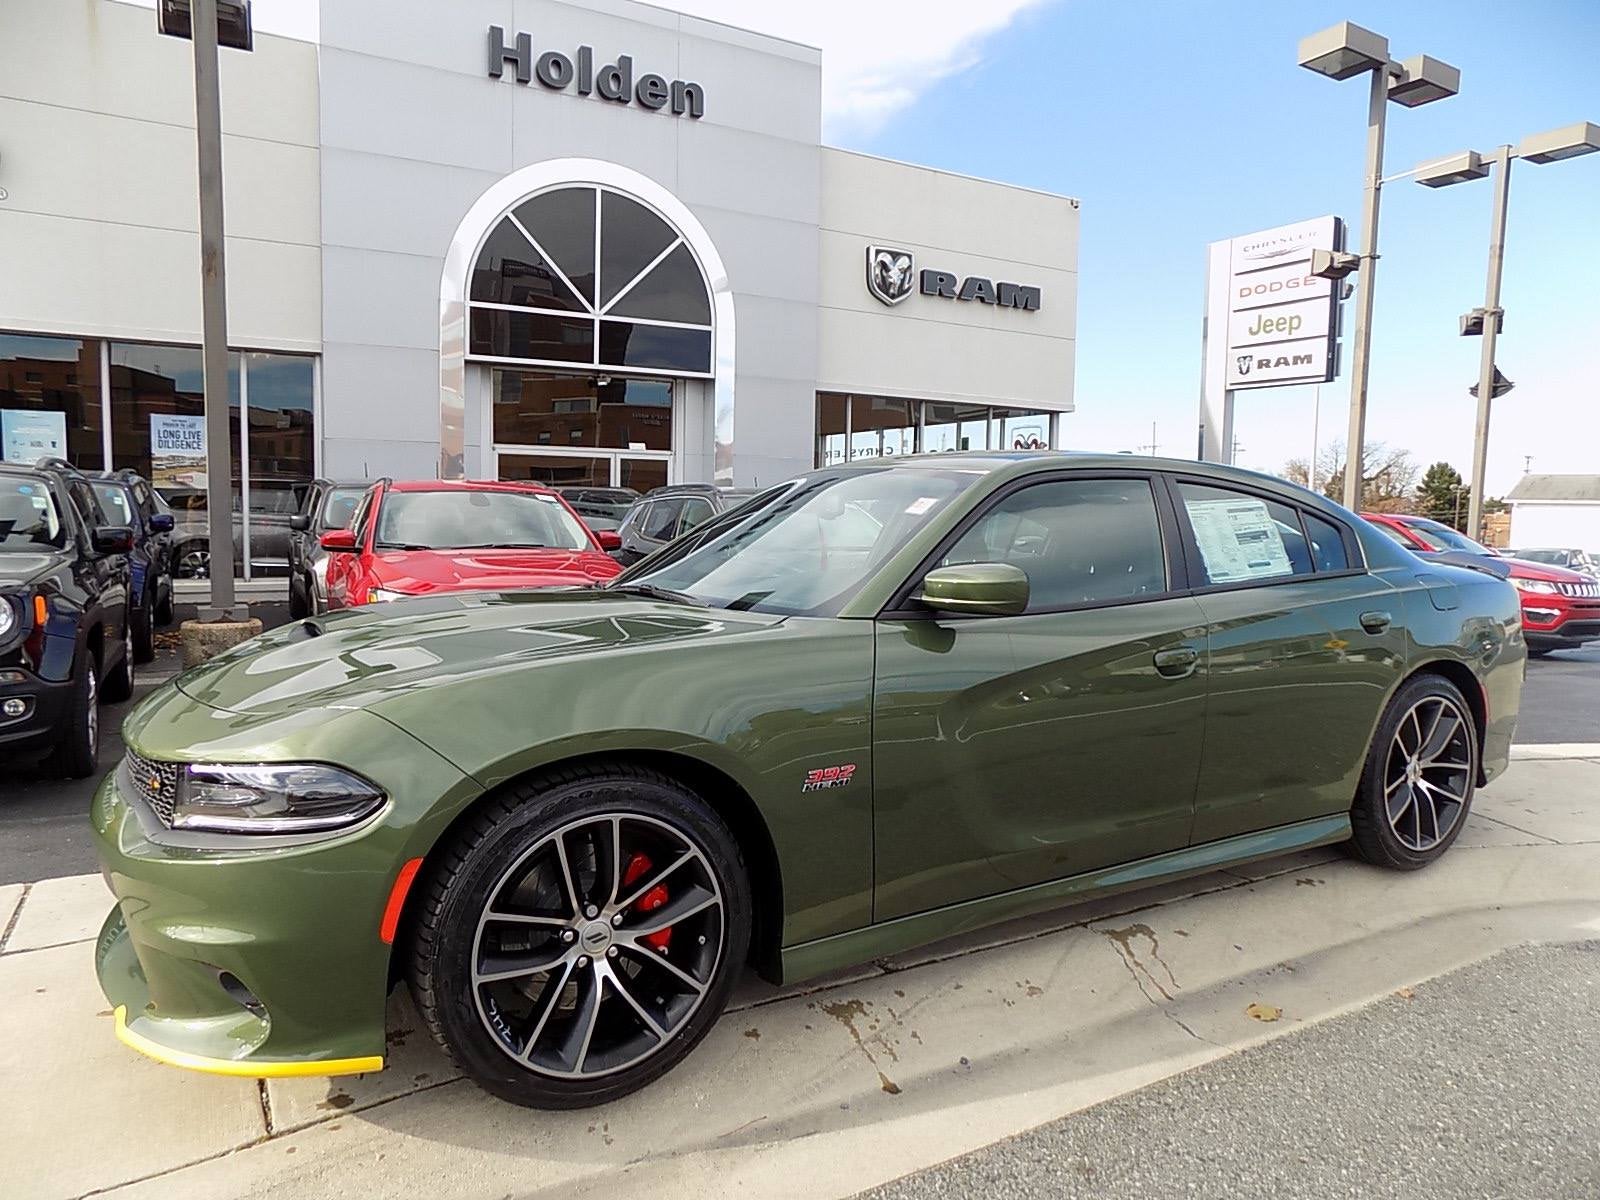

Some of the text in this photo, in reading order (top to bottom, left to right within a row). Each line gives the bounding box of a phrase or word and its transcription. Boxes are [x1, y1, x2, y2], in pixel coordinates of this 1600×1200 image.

[488, 25, 704, 119] Holden
[920, 269, 1041, 312] RAM
[1239, 275, 1317, 298] DODGE
[1249, 314, 1302, 336] Jeep
[1257, 354, 1313, 370] RAM
[158, 429, 202, 440] LONG LIVE
[158, 439, 203, 450] DILIGENCE
[805, 764, 856, 783] 392
